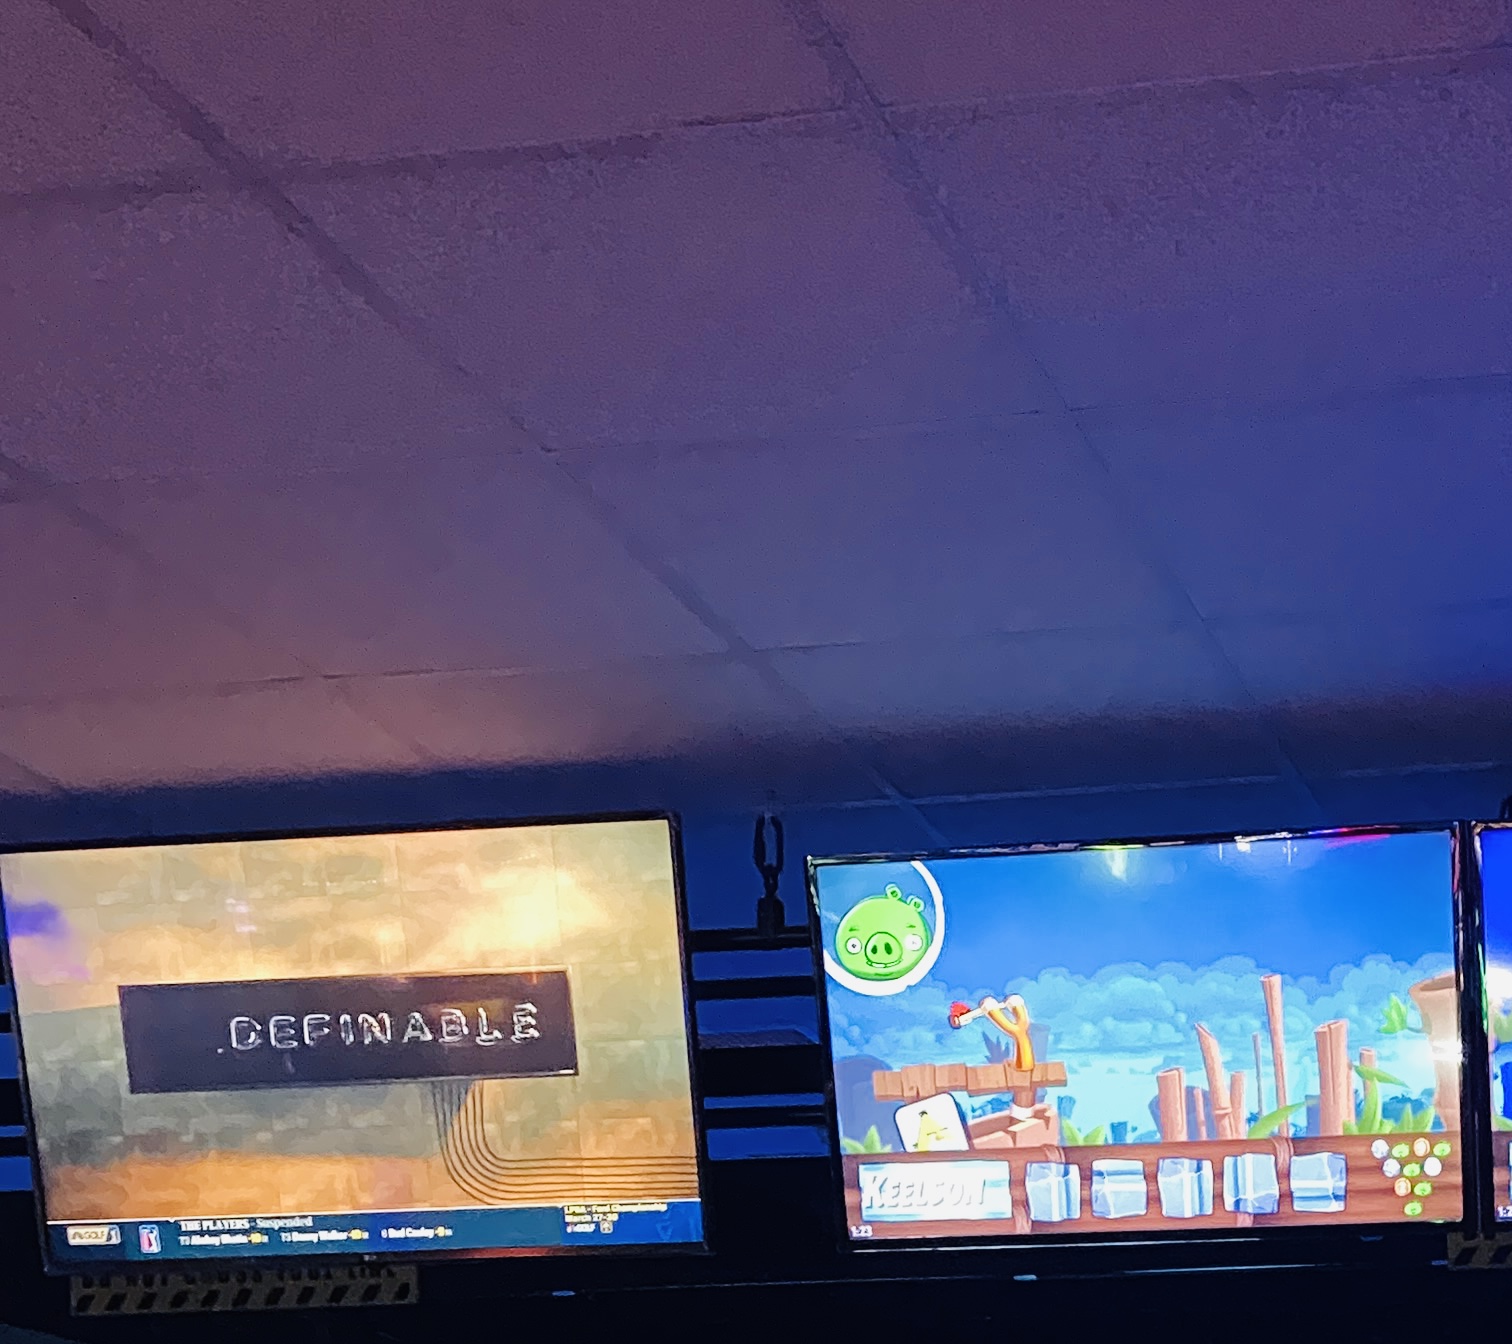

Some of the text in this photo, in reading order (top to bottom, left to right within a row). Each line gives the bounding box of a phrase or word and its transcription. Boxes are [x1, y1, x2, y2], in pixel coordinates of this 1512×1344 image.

[230, 1001, 540, 1050] DEFINABLE
[862, 1175, 987, 1209] KEELSON
[181, 1220, 202, 1231] THE
[202, 1219, 250, 1231] PLAYERS
[256, 1216, 313, 1230] Suspended
